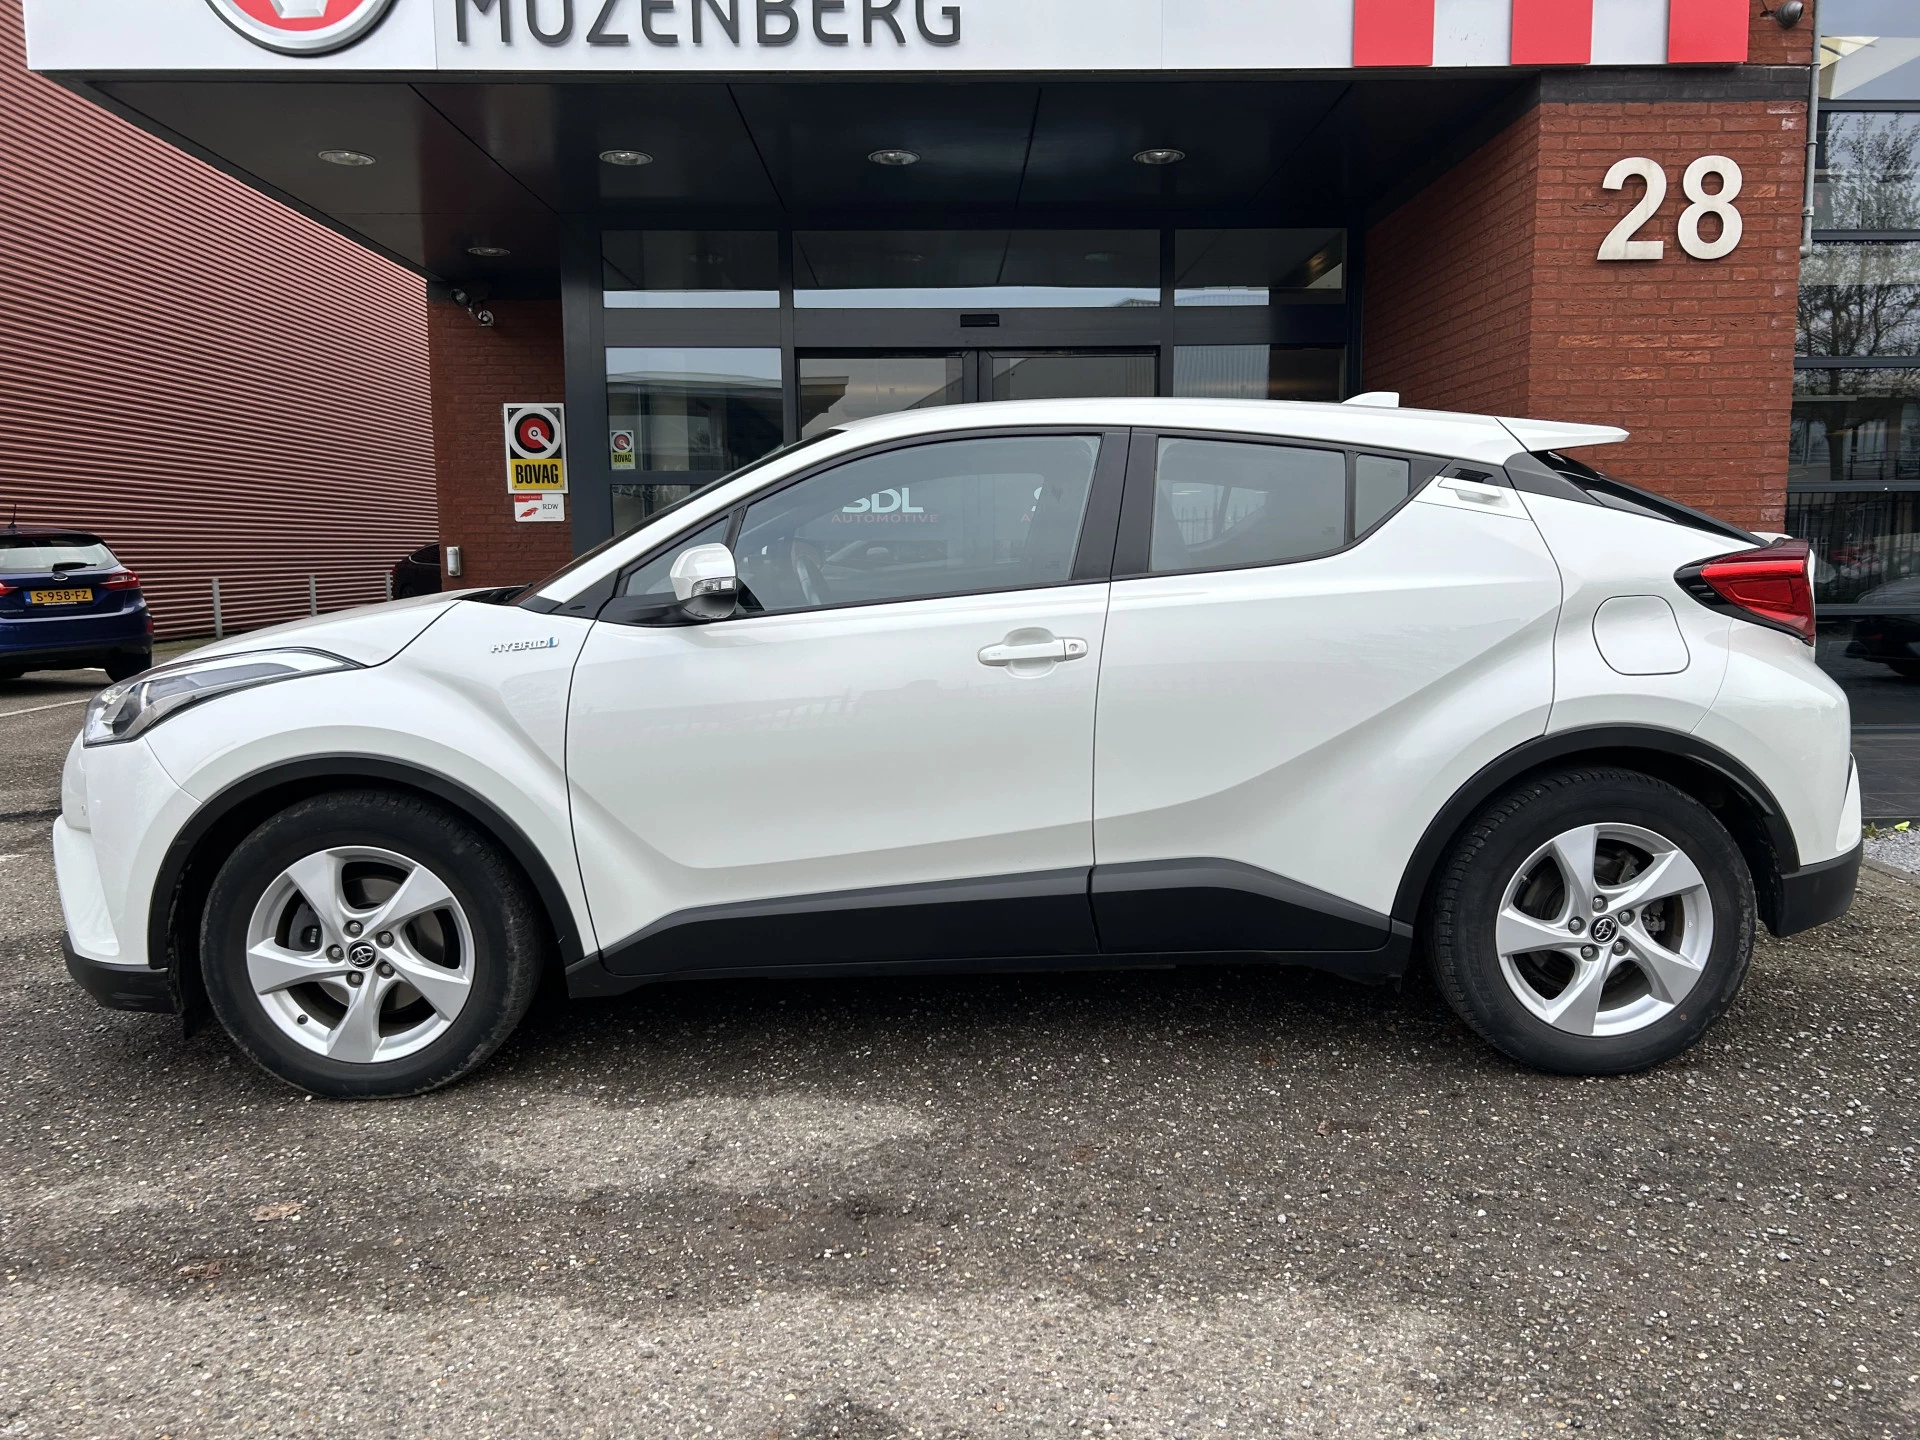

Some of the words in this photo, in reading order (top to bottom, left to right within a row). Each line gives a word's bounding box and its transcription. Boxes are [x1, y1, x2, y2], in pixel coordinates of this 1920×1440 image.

[1597, 155, 1743, 260] 28
[613, 453, 632, 463] BOVAG
[515, 463, 559, 485] BOVAG
[842, 487, 925, 513] SDL
[831, 514, 938, 524] AUTOMOTIVE
[35, 590, 89, 602] S-958-FZ
[490, 640, 549, 654] HYBRID
